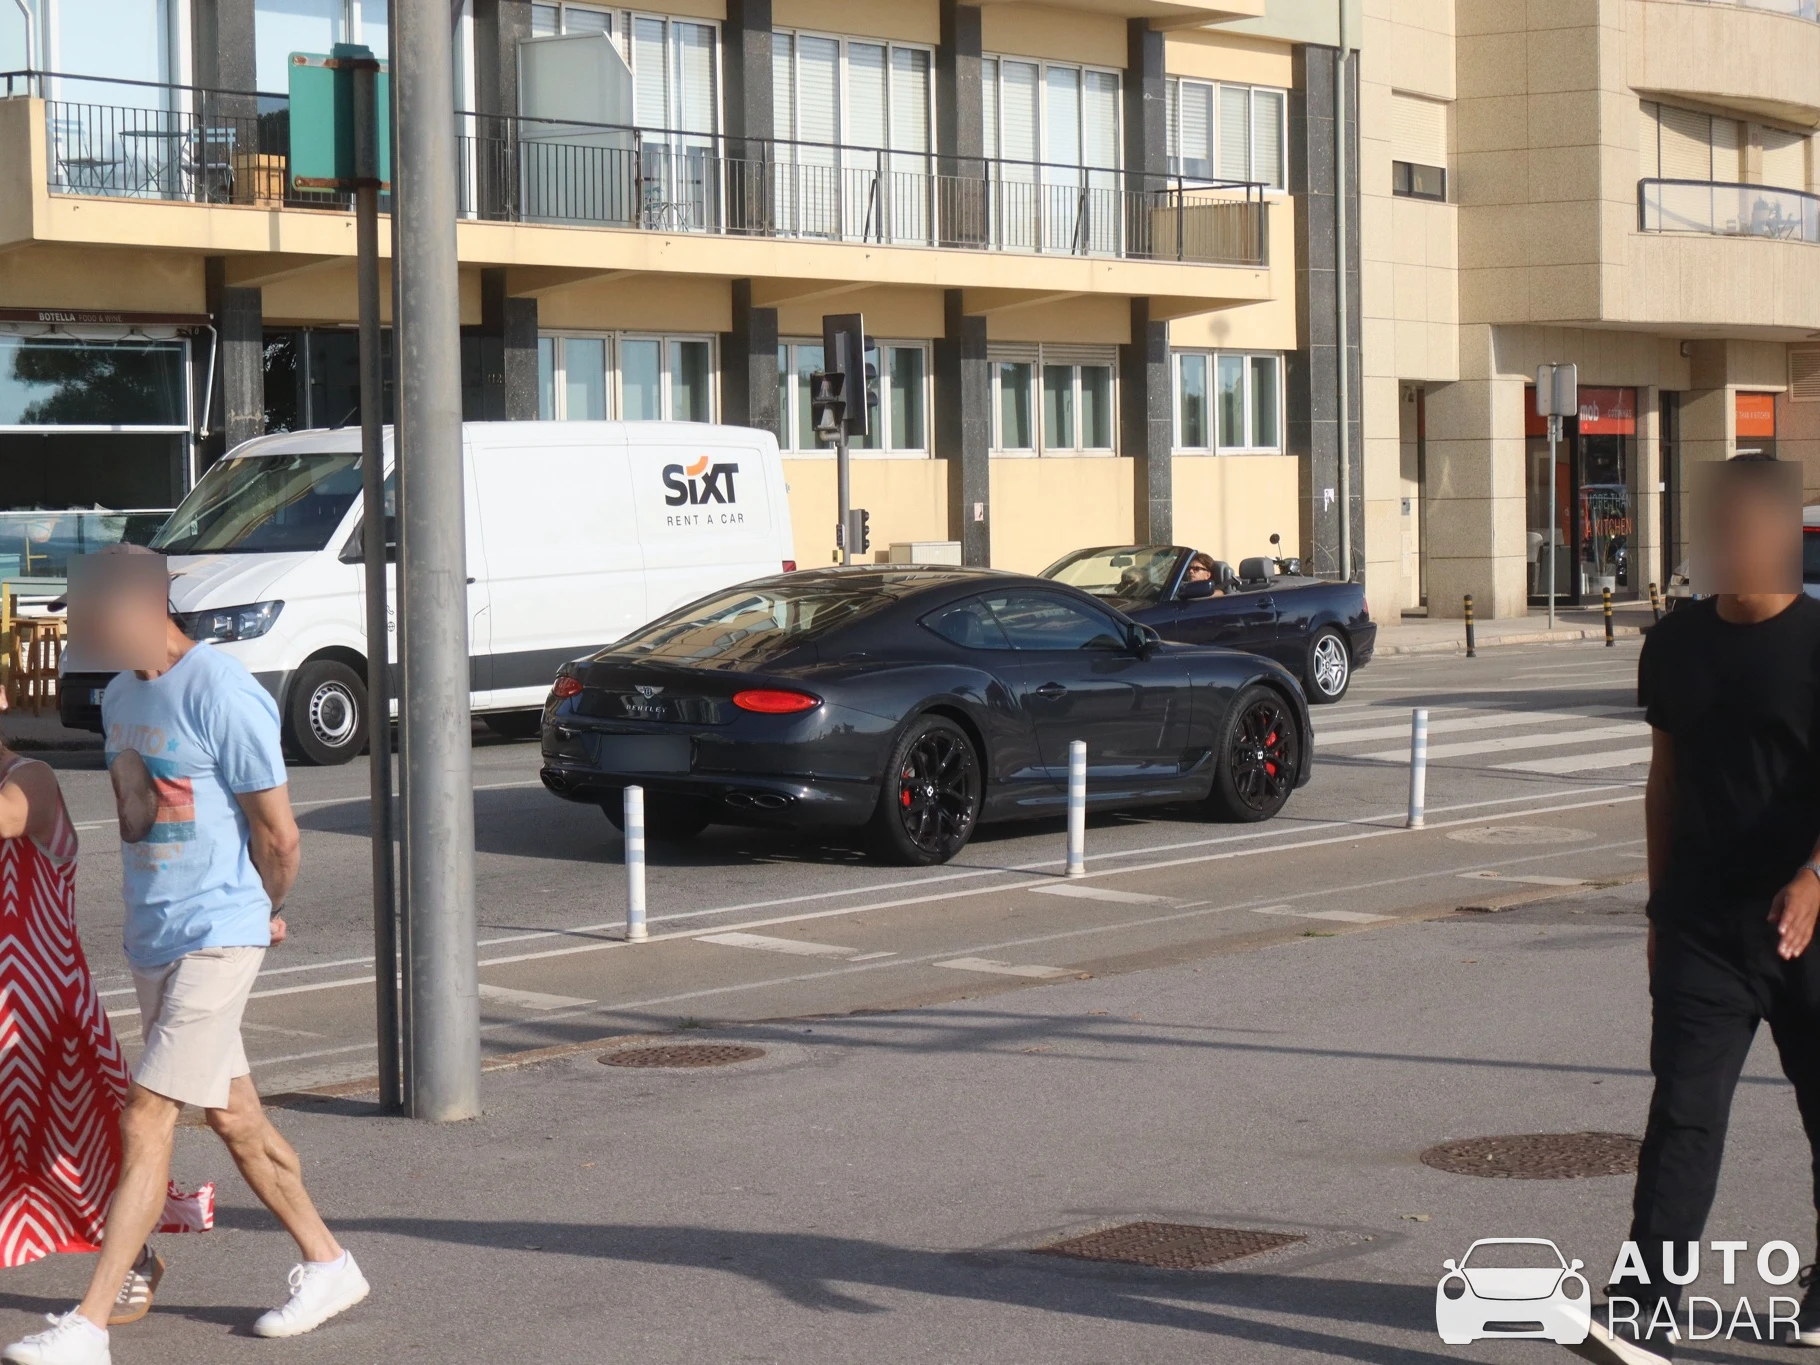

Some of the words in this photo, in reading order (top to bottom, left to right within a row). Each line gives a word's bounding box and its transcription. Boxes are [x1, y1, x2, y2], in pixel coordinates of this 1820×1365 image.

[38, 312, 76, 322] BOTELLA
[78, 314, 97, 322] FOOD
[98, 314, 104, 322] &
[104, 314, 122, 323] WINE
[1579, 400, 1599, 422] mob
[667, 514, 699, 526] RENT
[707, 514, 713, 524] A
[720, 513, 744, 524] CAR
[1595, 517, 1632, 537] KITCHEN
[626, 704, 668, 713] BENTLEY
